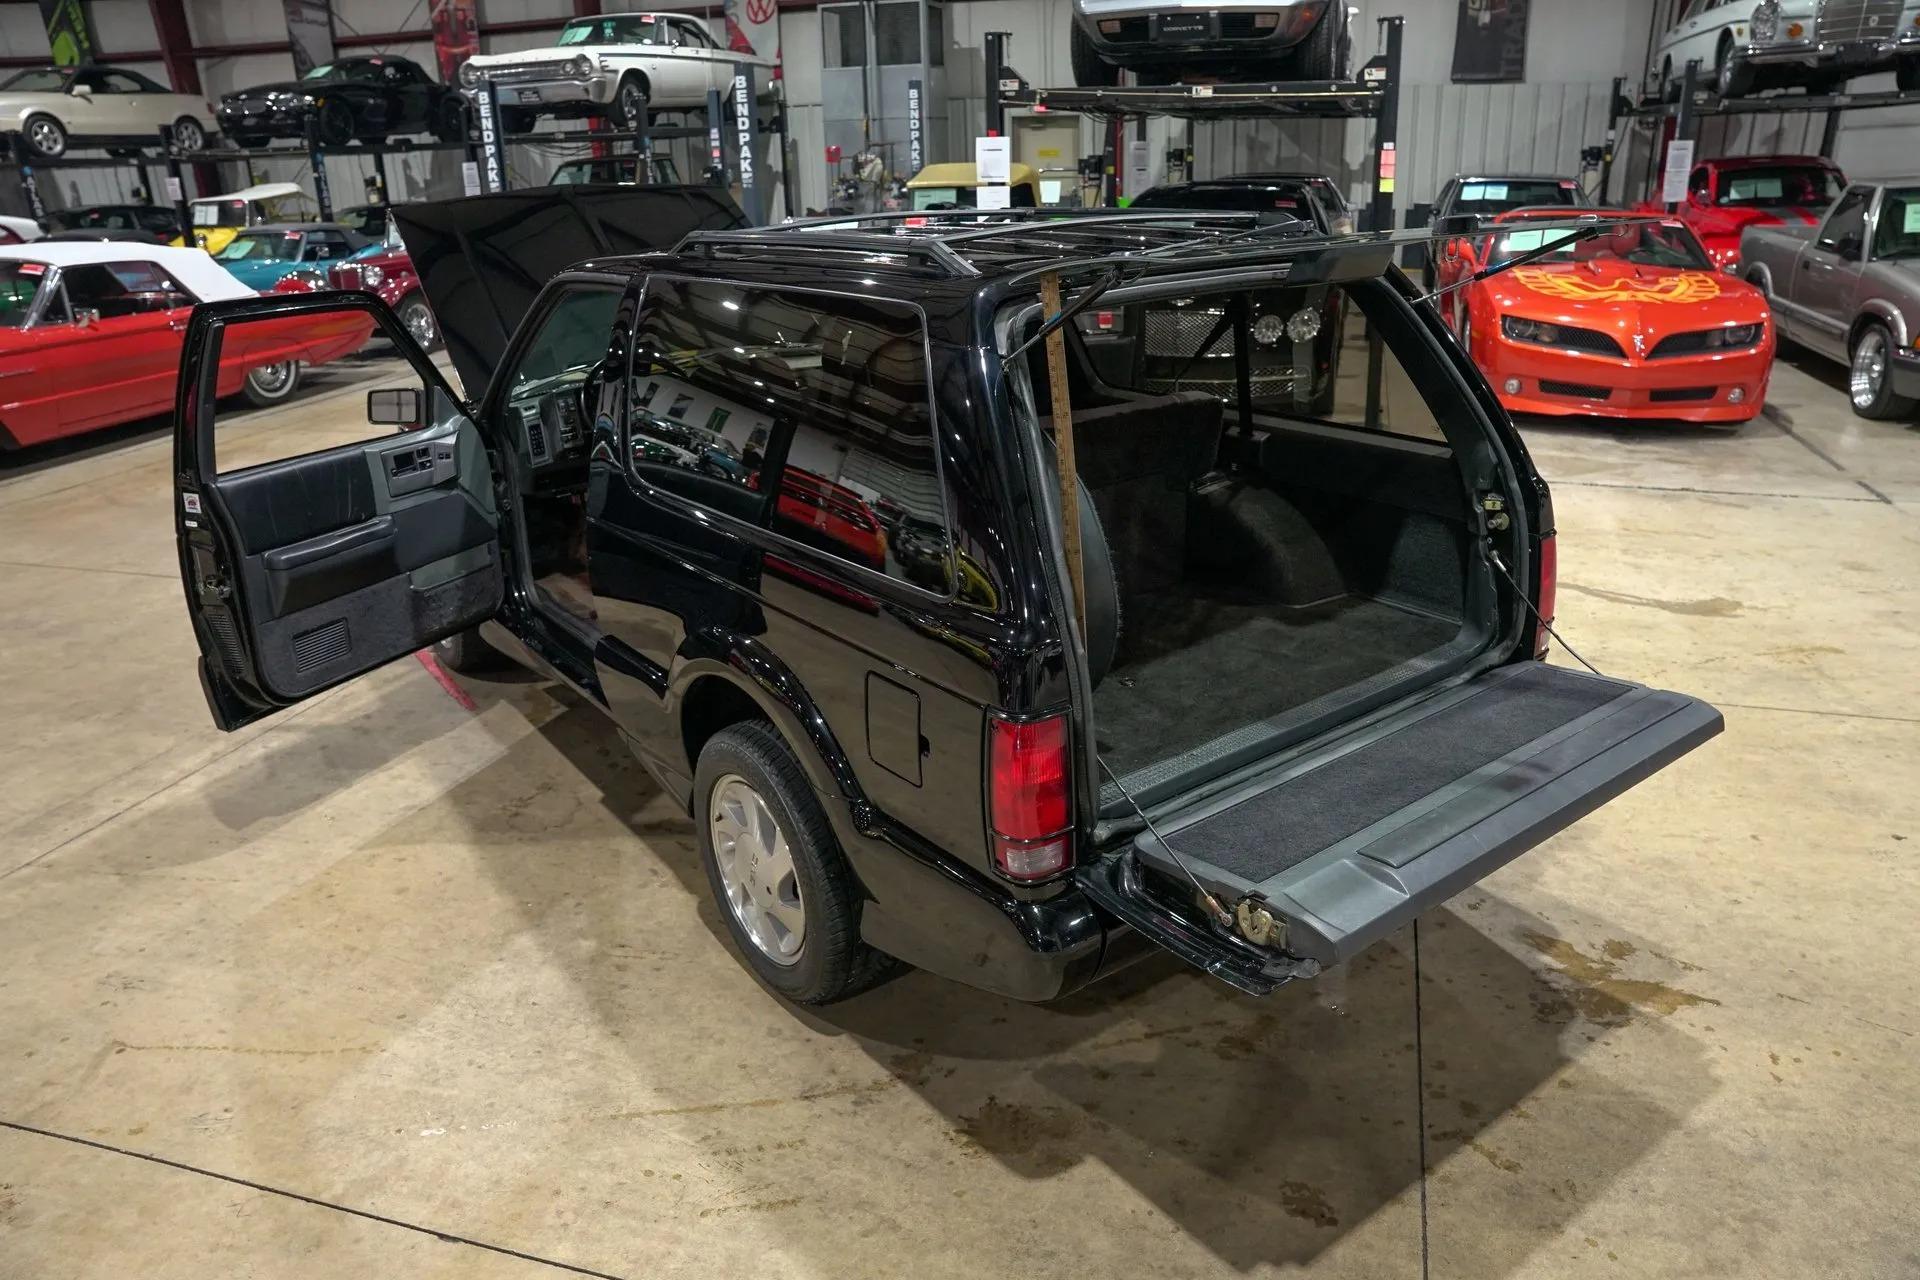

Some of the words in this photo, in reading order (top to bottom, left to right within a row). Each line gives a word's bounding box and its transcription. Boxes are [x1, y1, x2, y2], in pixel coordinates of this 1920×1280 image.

[478, 91, 500, 182] BENDPAK
[735, 75, 753, 172] BENDPAK
[908, 88, 921, 160] BENDPAK
